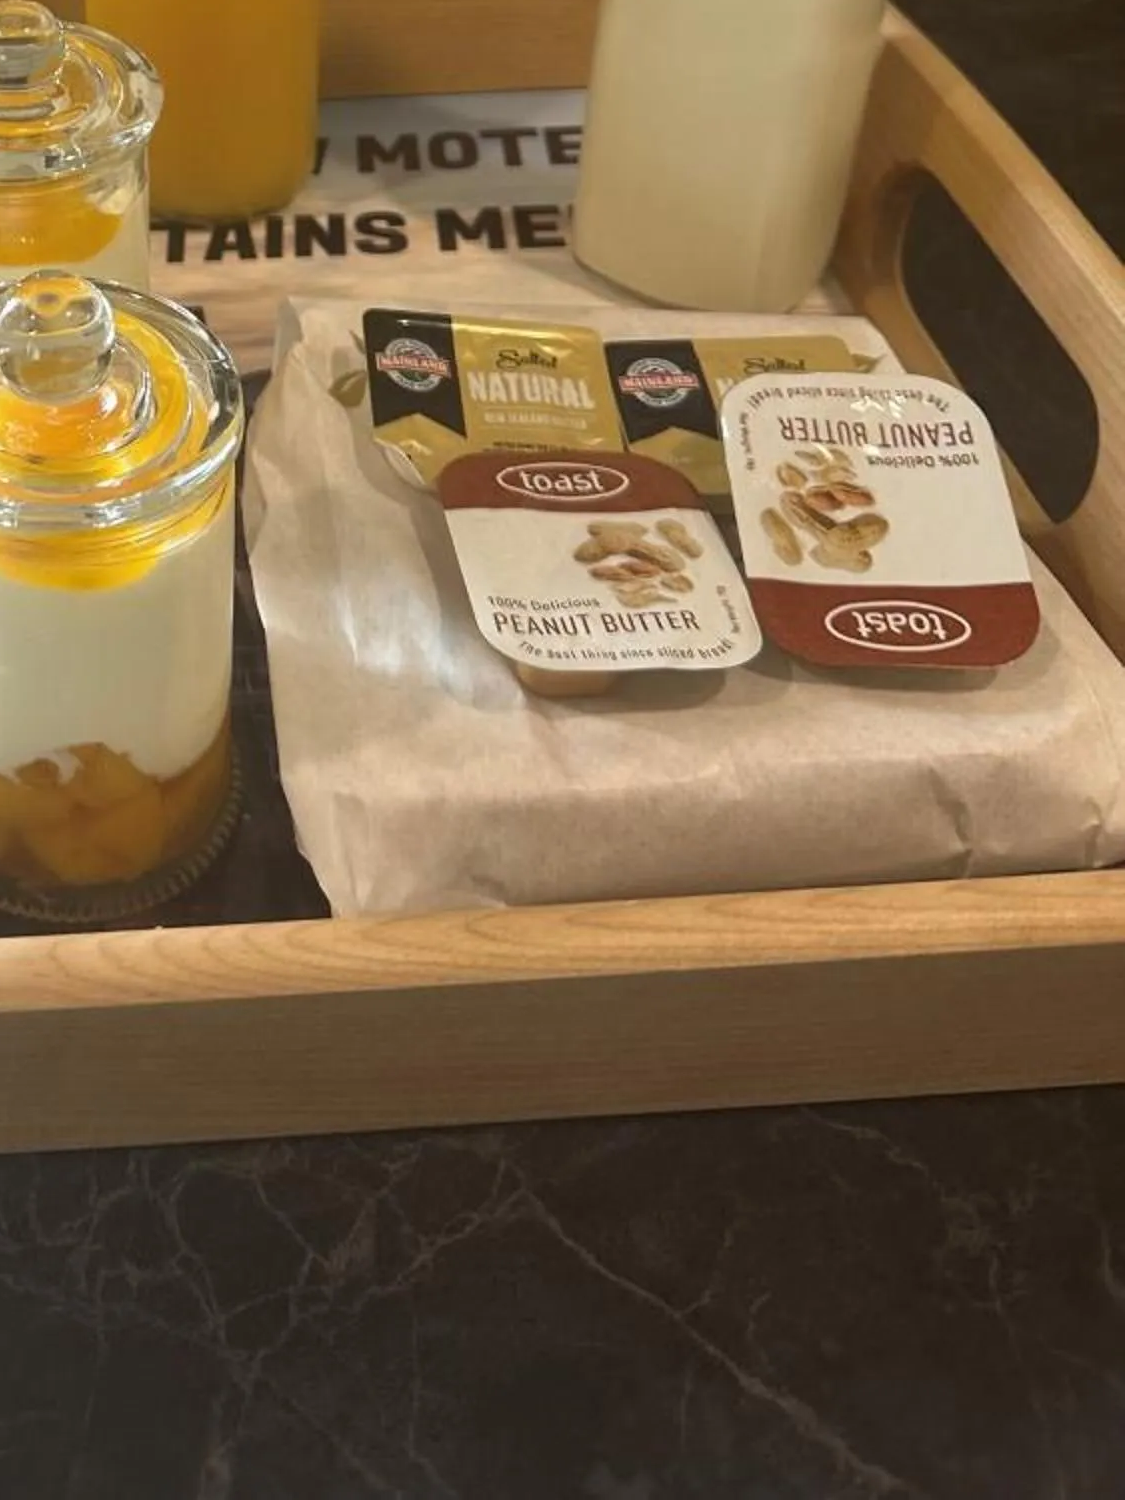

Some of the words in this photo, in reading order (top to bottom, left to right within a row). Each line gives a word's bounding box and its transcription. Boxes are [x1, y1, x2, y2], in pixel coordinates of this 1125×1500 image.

[355, 126, 583, 175] MOTE
[149, 211, 409, 264] TAINS
[496, 349, 558, 369] Salted
[467, 372, 595, 409] NATURAL
[778, 416, 868, 447] BUTTER
[876, 421, 974, 448] PEANUT
[866, 454, 937, 469] Delicious
[940, 451, 979, 466] 100%
[519, 467, 606, 494] toast
[488, 595, 527, 610] 100%
[530, 596, 601, 611] Delicious
[493, 611, 591, 637] PEANUT
[601, 610, 701, 634] BUTTER
[854, 611, 947, 640] toast
